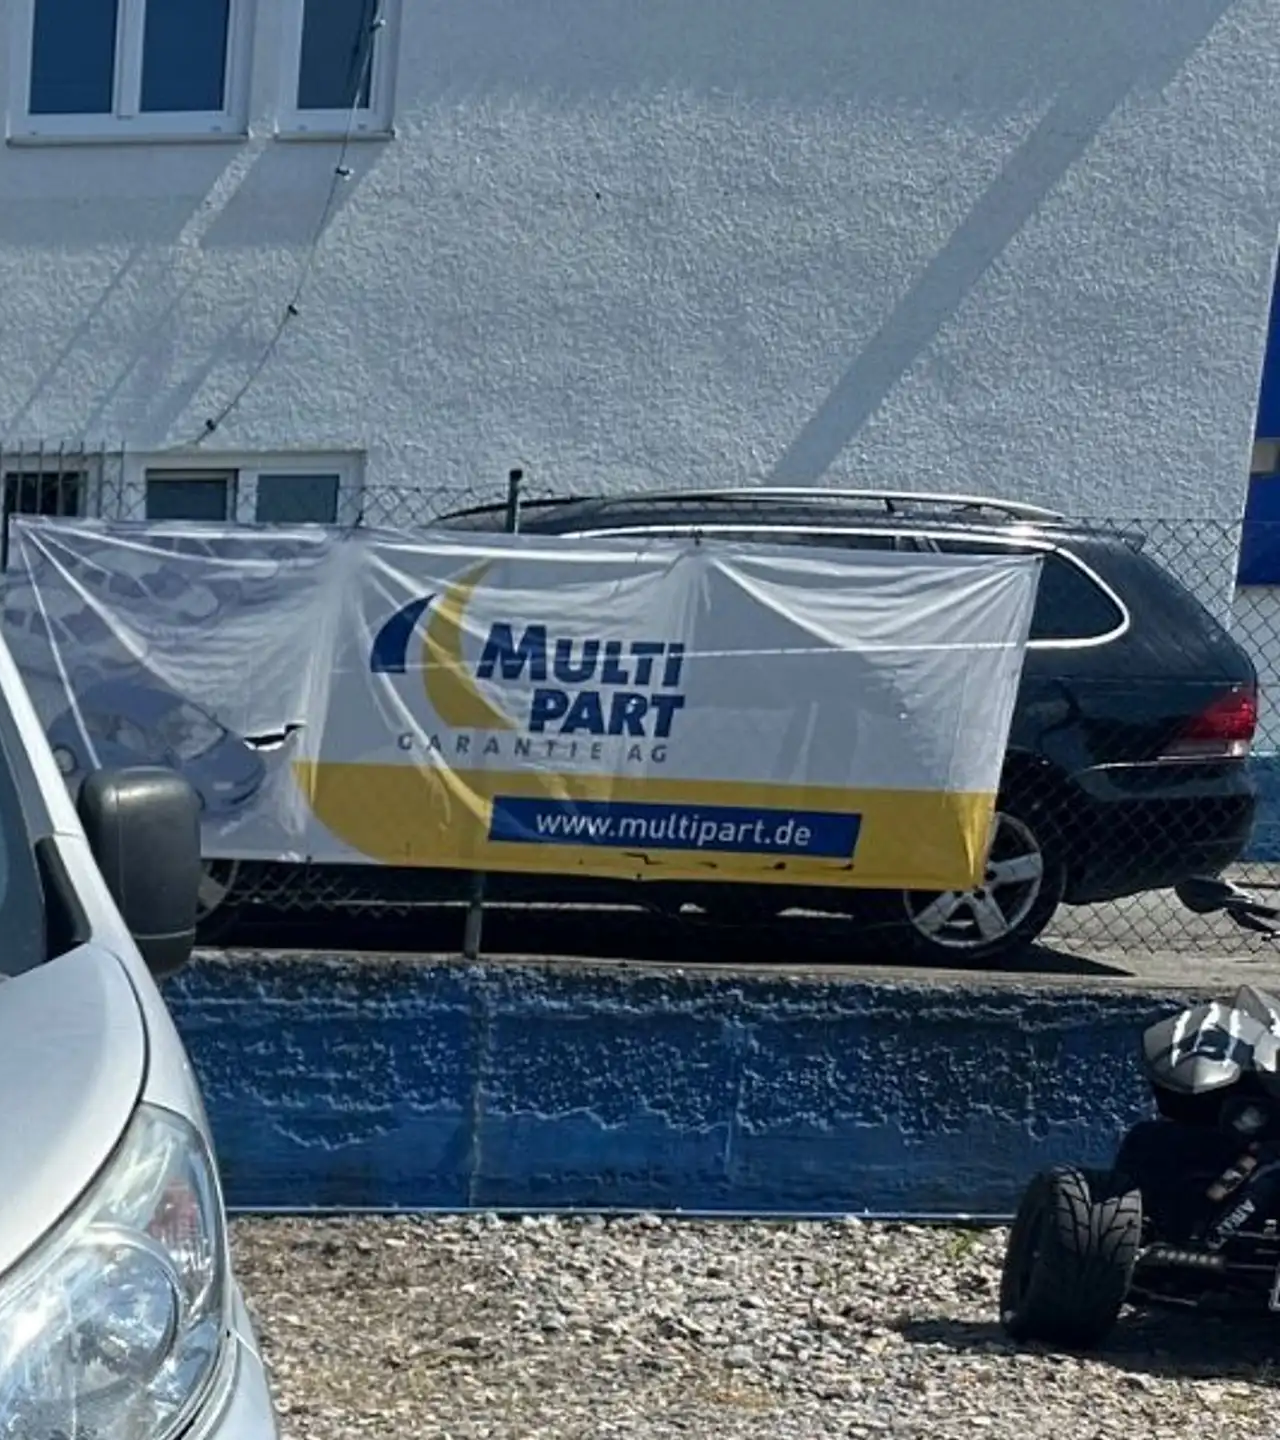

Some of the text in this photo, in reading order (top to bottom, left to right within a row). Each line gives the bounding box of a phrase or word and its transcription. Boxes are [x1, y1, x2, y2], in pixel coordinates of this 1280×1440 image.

[477, 622, 686, 688] MULTI
[528, 688, 686, 738] PART
[397, 732, 668, 764] GARANTIE AG
[536, 811, 813, 847] www.multipart.de
